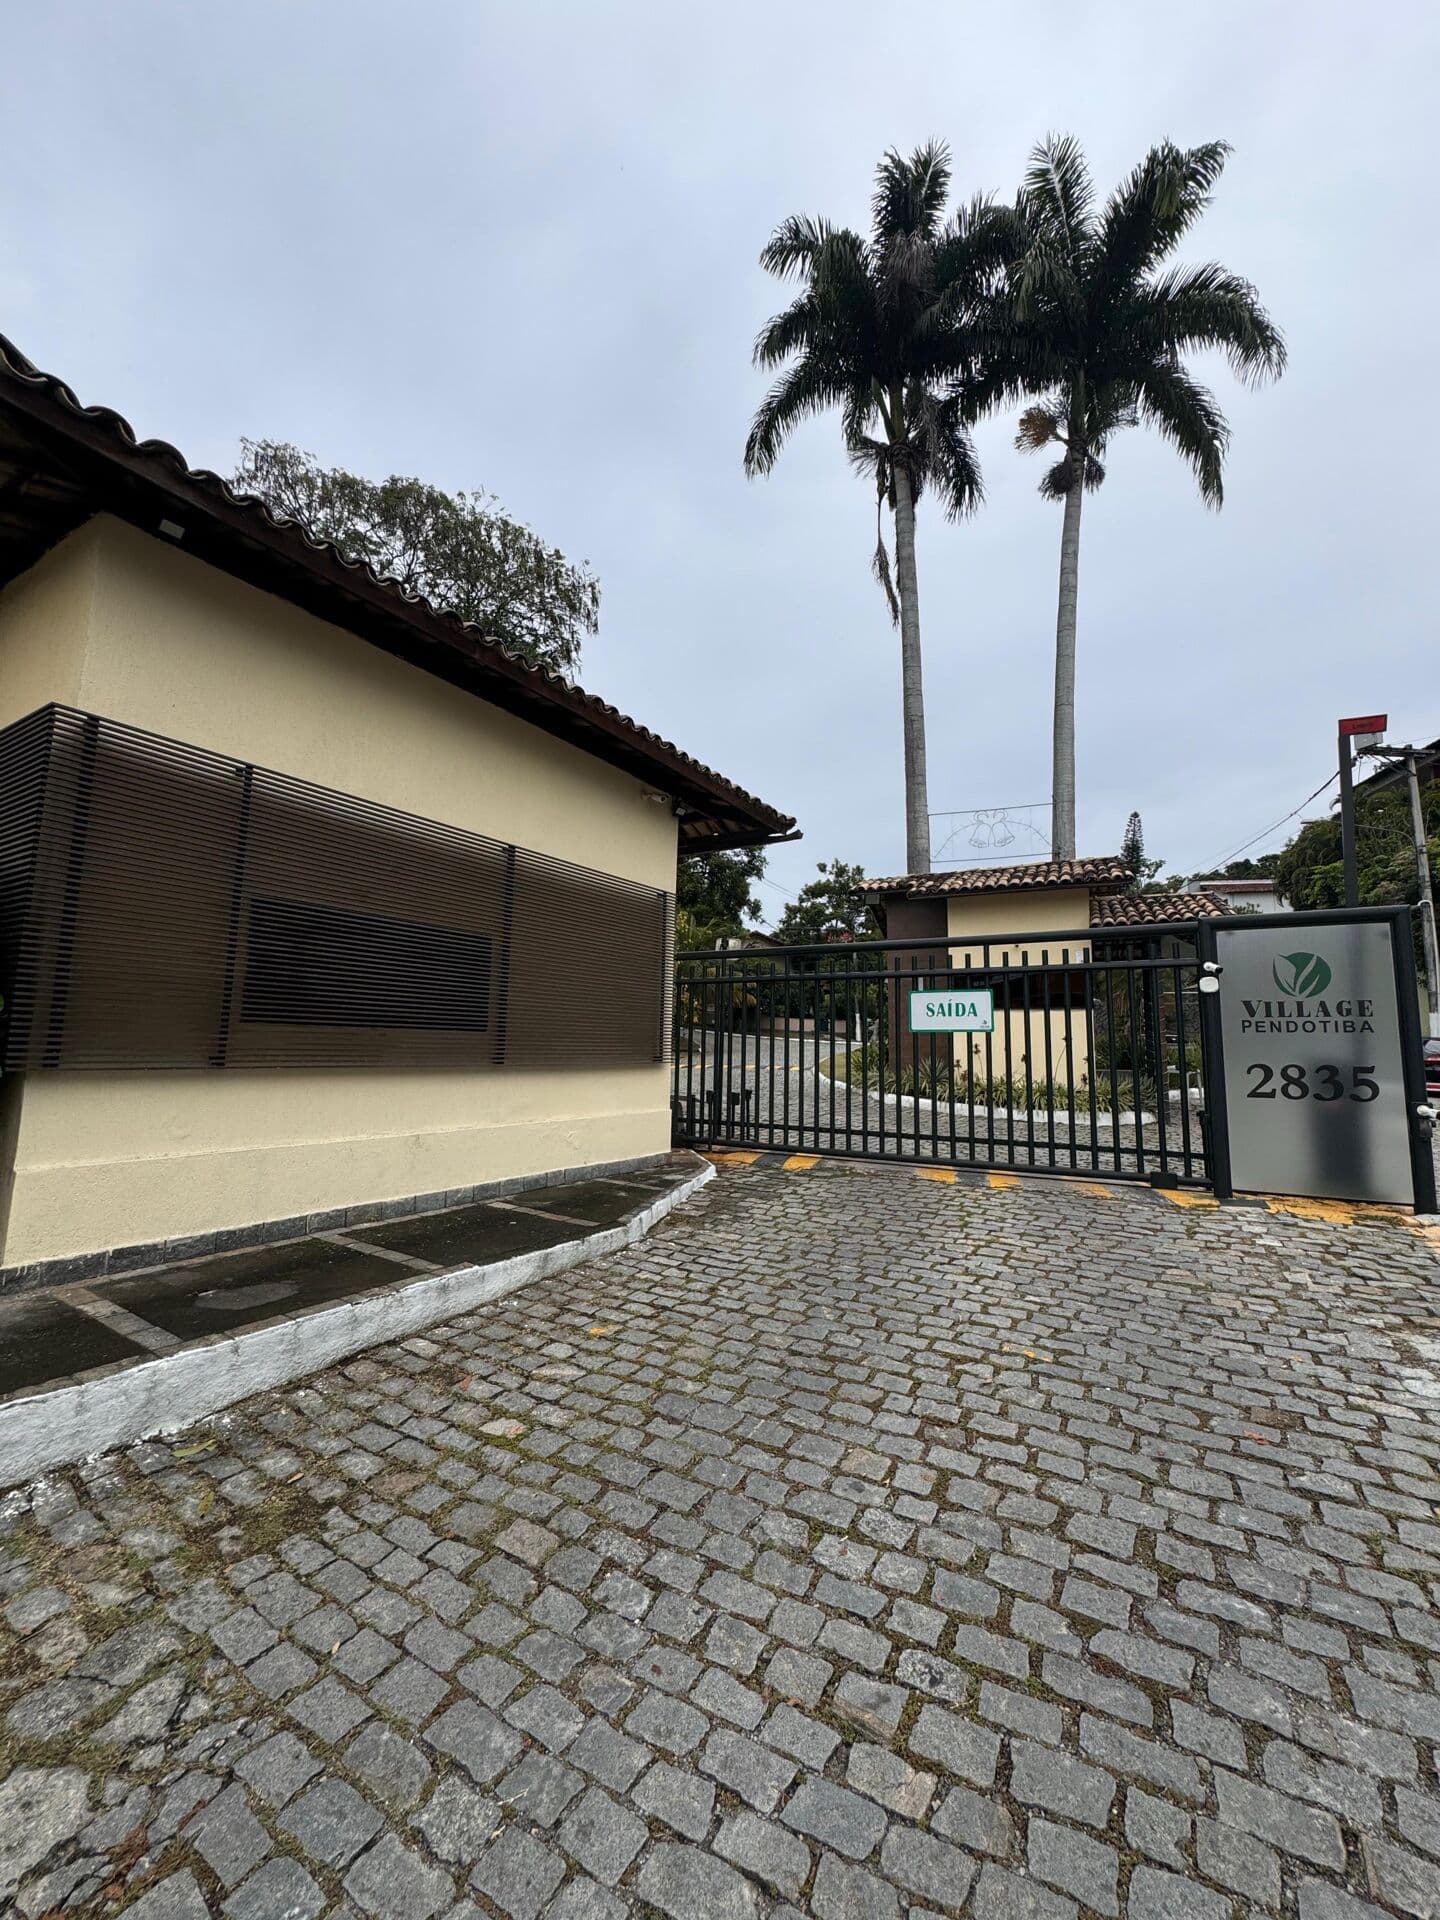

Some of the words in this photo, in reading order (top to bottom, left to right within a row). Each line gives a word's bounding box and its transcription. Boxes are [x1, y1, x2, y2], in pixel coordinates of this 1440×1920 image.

[926, 998, 978, 1017] SAÍDA
[1240, 1000, 1374, 1018] VILLAGE
[1241, 1019, 1375, 1034] PENDOTIBA
[1246, 1063, 1380, 1102] 2835
